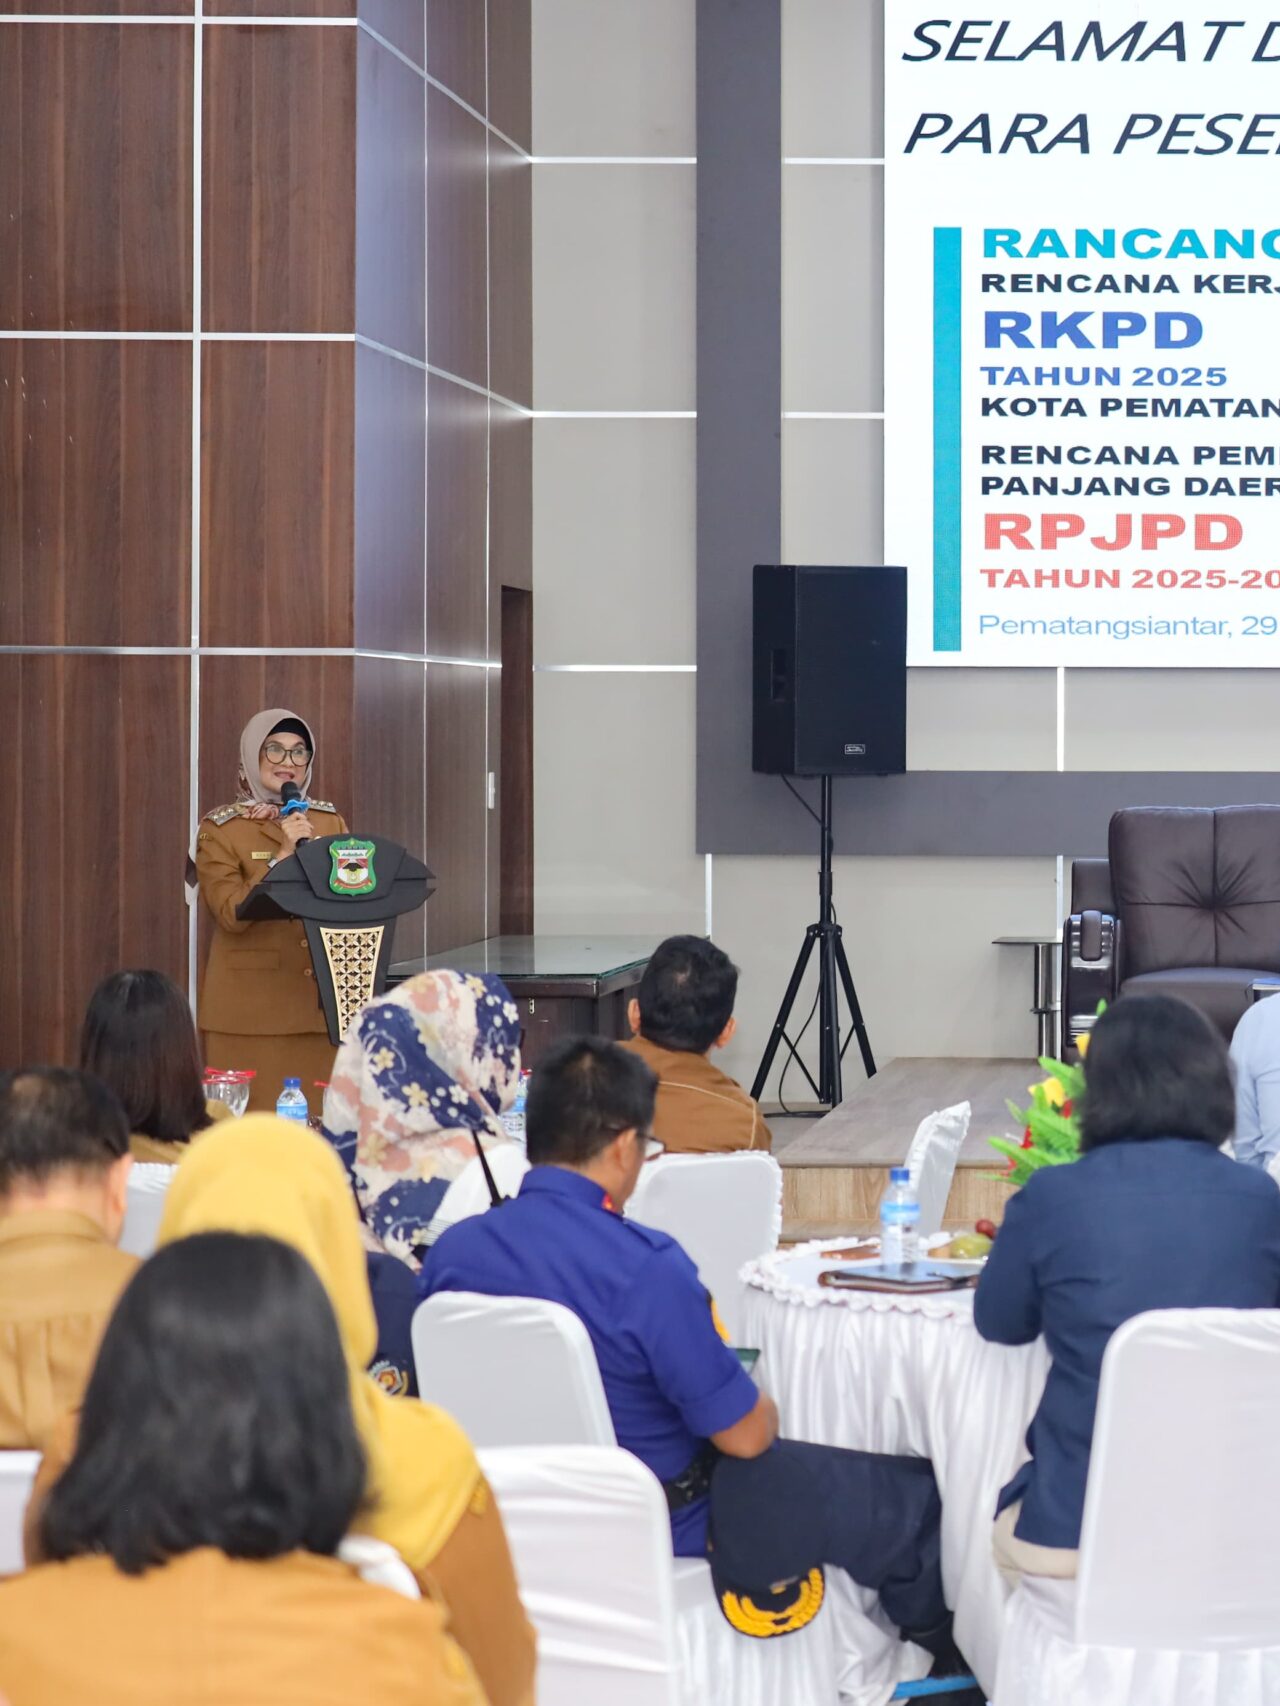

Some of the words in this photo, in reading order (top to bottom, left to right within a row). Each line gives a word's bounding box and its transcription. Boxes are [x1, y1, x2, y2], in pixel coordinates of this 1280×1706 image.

[901, 19, 1246, 63] SELAMAT
[902, 112, 1091, 155] PARA
[981, 273, 1181, 294] RENCANA
[984, 310, 1204, 350] RKPD
[979, 366, 1121, 387] TAHUN
[1131, 366, 1228, 387] 2025
[981, 397, 1088, 418] KOTA
[981, 444, 1180, 466] RENCANA
[981, 475, 1171, 497] PANJANG
[984, 512, 1243, 552] RPJPD
[979, 568, 1120, 589] TAHUN
[979, 614, 1232, 640] Pematangsiantar,
[1241, 615, 1278, 636] 29
